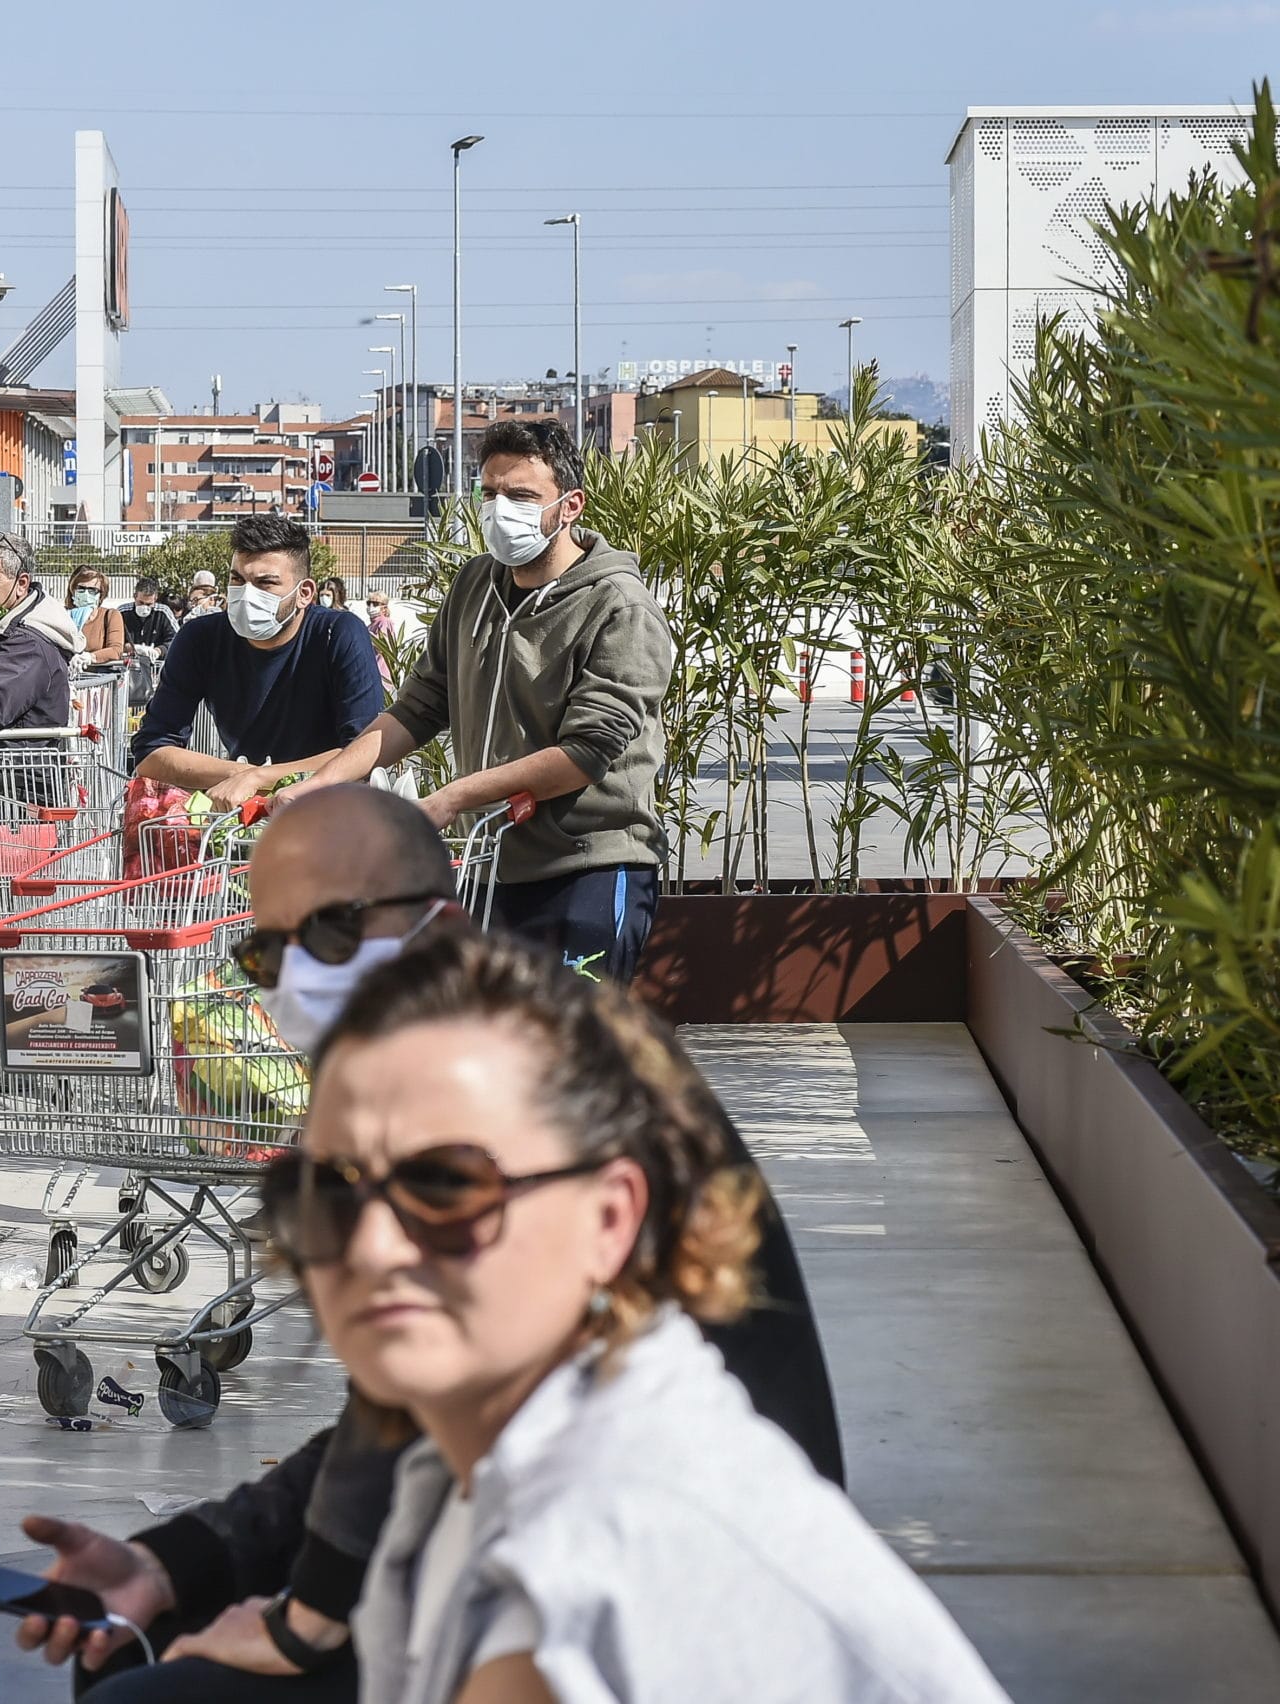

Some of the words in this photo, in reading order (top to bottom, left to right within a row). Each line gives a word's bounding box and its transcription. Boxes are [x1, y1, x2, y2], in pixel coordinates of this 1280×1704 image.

[649, 360, 763, 374] OSPEDALE
[308, 462, 332, 474] SOP
[115, 534, 151, 543] USCITA
[16, 971, 63, 987] CARROZZERIA
